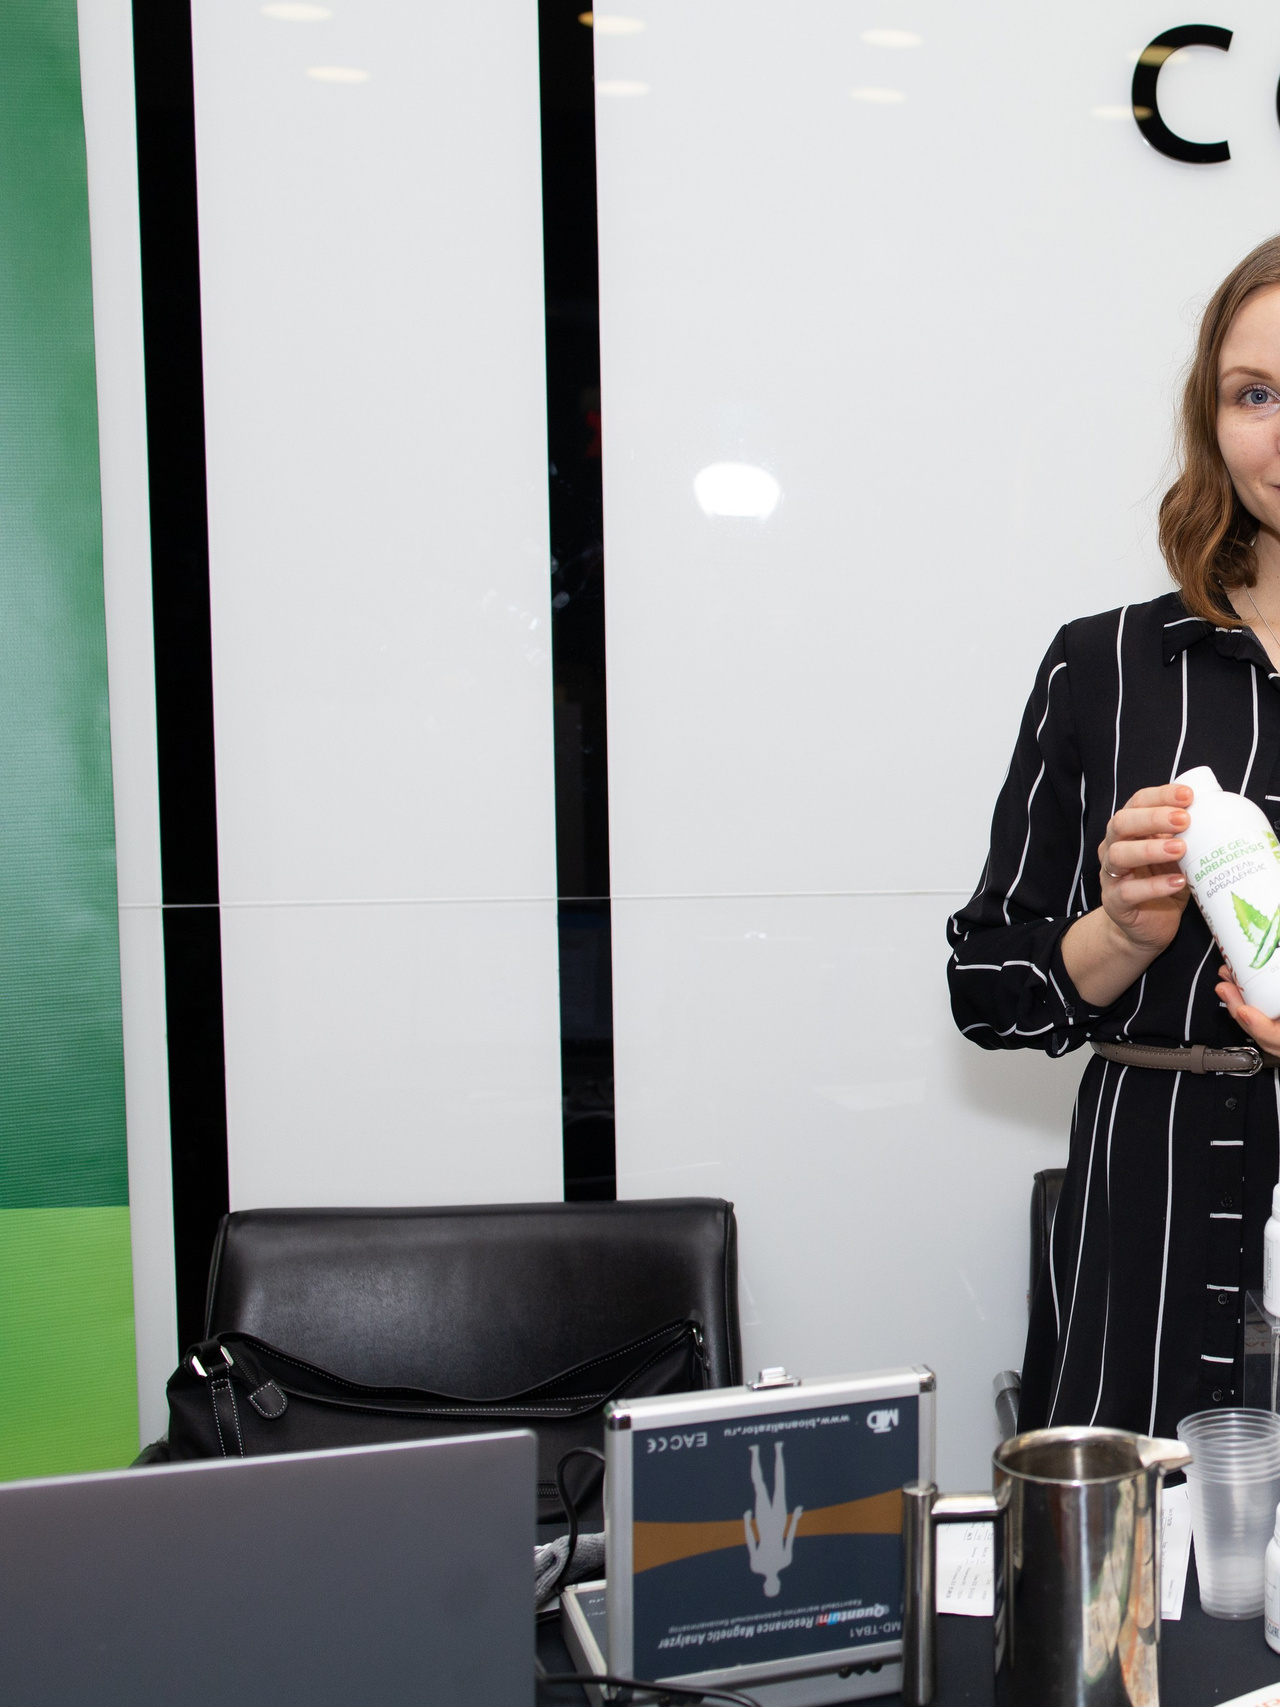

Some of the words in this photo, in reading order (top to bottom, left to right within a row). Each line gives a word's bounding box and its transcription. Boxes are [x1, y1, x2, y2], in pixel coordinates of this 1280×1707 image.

[1194, 842, 1265, 882] BARBADENSIS
[1199, 846, 1227, 867] ALOE
[1227, 838, 1249, 851] GEL
[1206, 863, 1267, 898] БАРБАДЕНСИС
[1208, 870, 1231, 887] АЛОЭ
[1231, 860, 1255, 873] ГЕЛЬ
[724, 1414, 850, 1437] www.bioanalizator.ru
[671, 1432, 708, 1450] EAC
[756, 1615, 814, 1634] Resonance
[817, 1603, 890, 1626] Quantum
[658, 1632, 706, 1649] Analyzer
[706, 1625, 756, 1643] Magnetic
[850, 1620, 902, 1638] MD-TBA1
